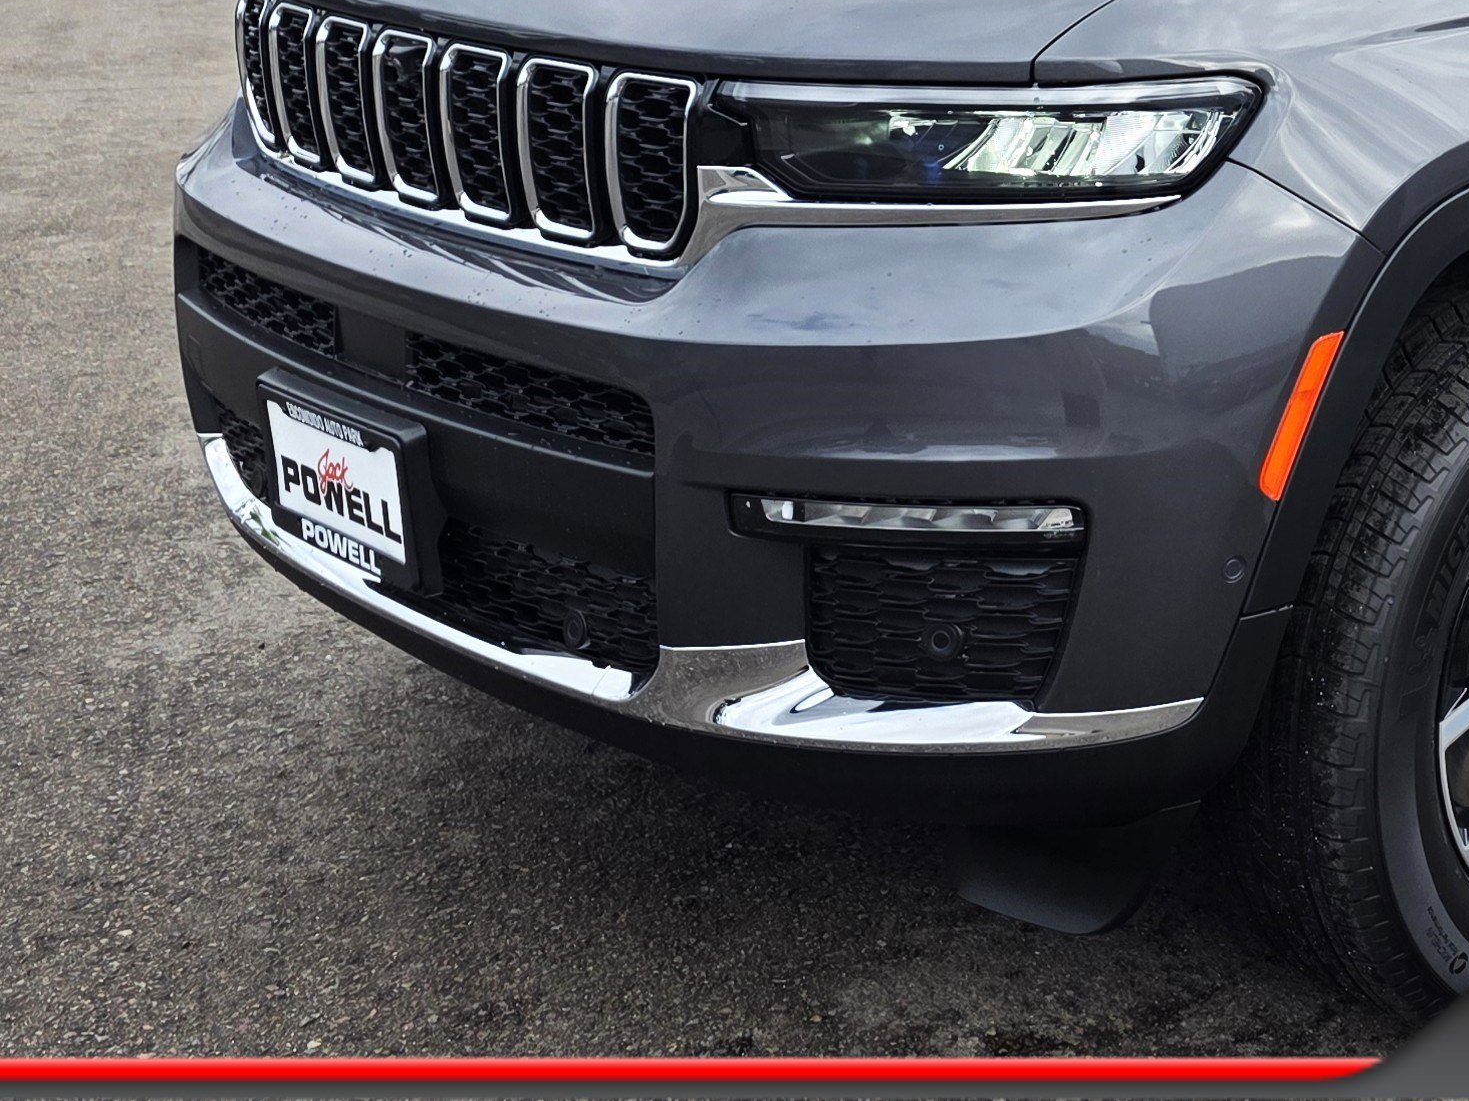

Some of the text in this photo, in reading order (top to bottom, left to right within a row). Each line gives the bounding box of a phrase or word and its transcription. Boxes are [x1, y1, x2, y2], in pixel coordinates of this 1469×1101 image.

[280, 454, 402, 545] POWELL
[317, 448, 354, 496] Jack
[301, 517, 382, 576] POWELL
